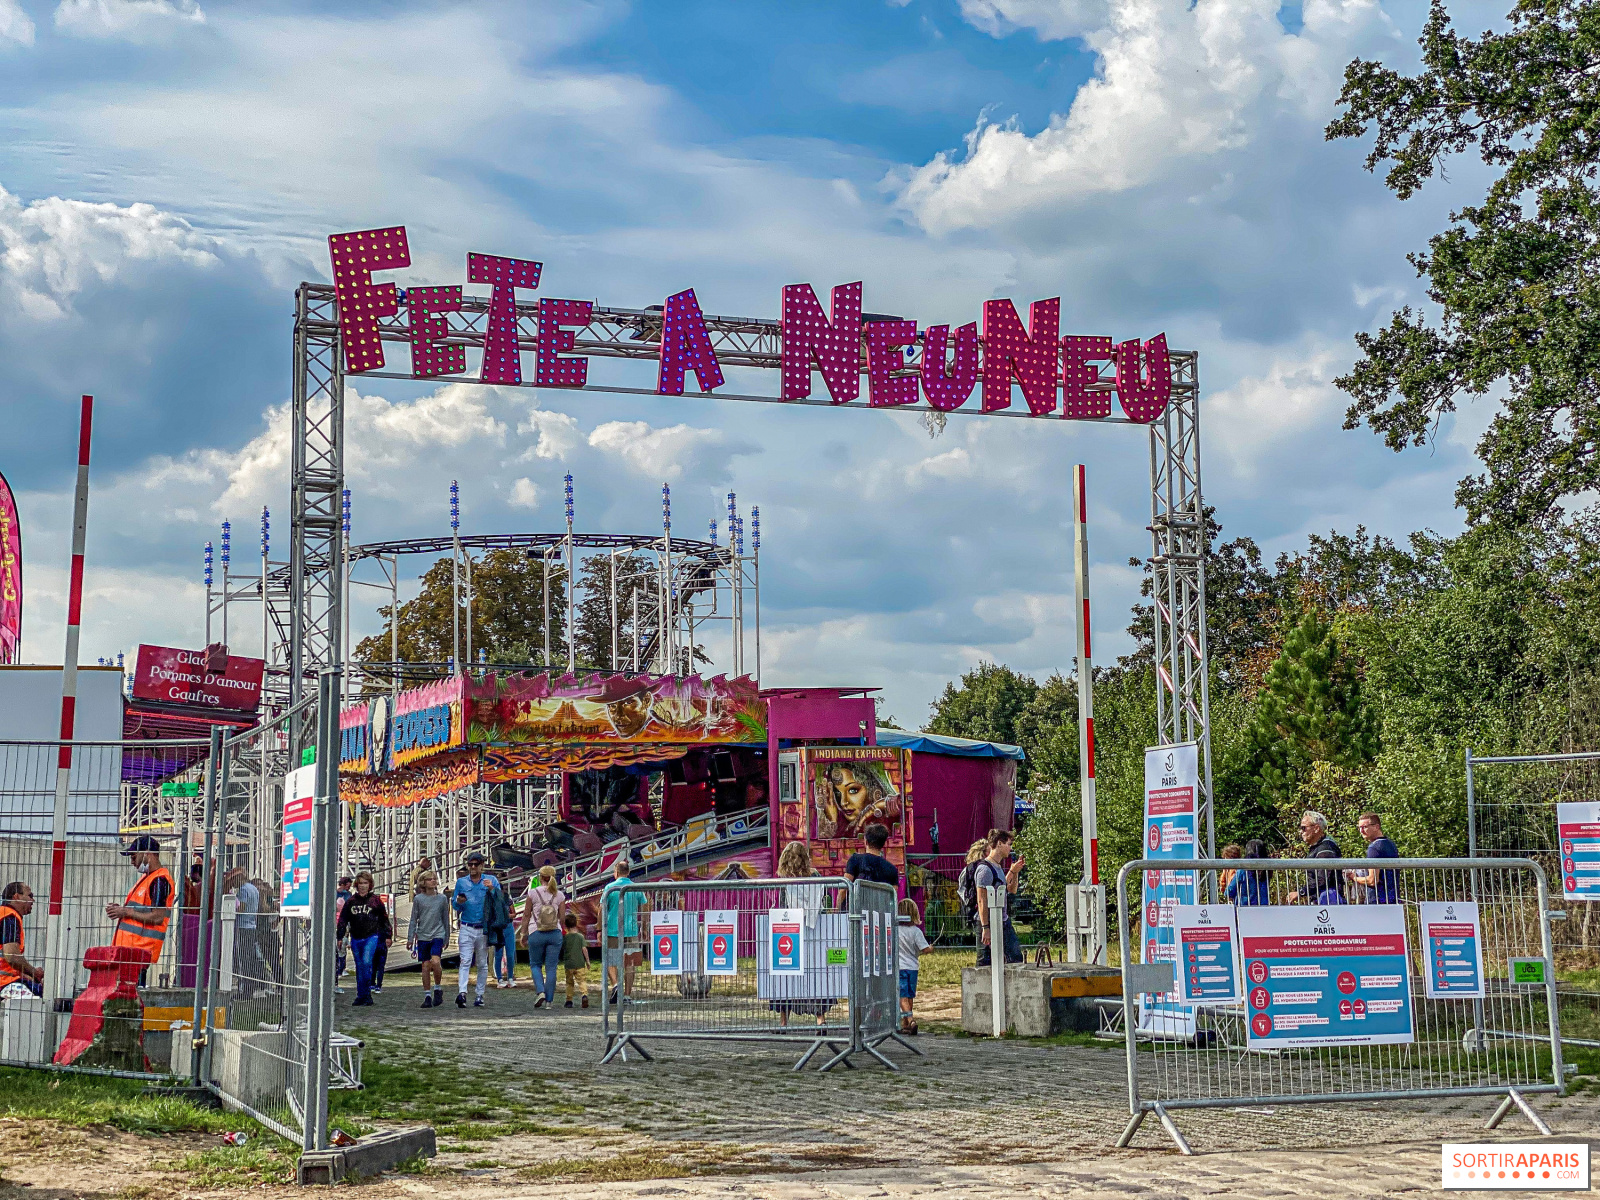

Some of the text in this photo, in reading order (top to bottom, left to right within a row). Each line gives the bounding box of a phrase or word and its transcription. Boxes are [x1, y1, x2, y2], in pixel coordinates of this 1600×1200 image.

[656, 287, 727, 395] A
[150, 665, 257, 691] Pommes D'amour
[169, 686, 220, 705] Gaufres
[394, 703, 451, 752] EXPRESS
[815, 748, 893, 759] INDIANA EXPRESS
[1161, 776, 1178, 787] PARIS
[1314, 926, 1336, 934] PARIS
